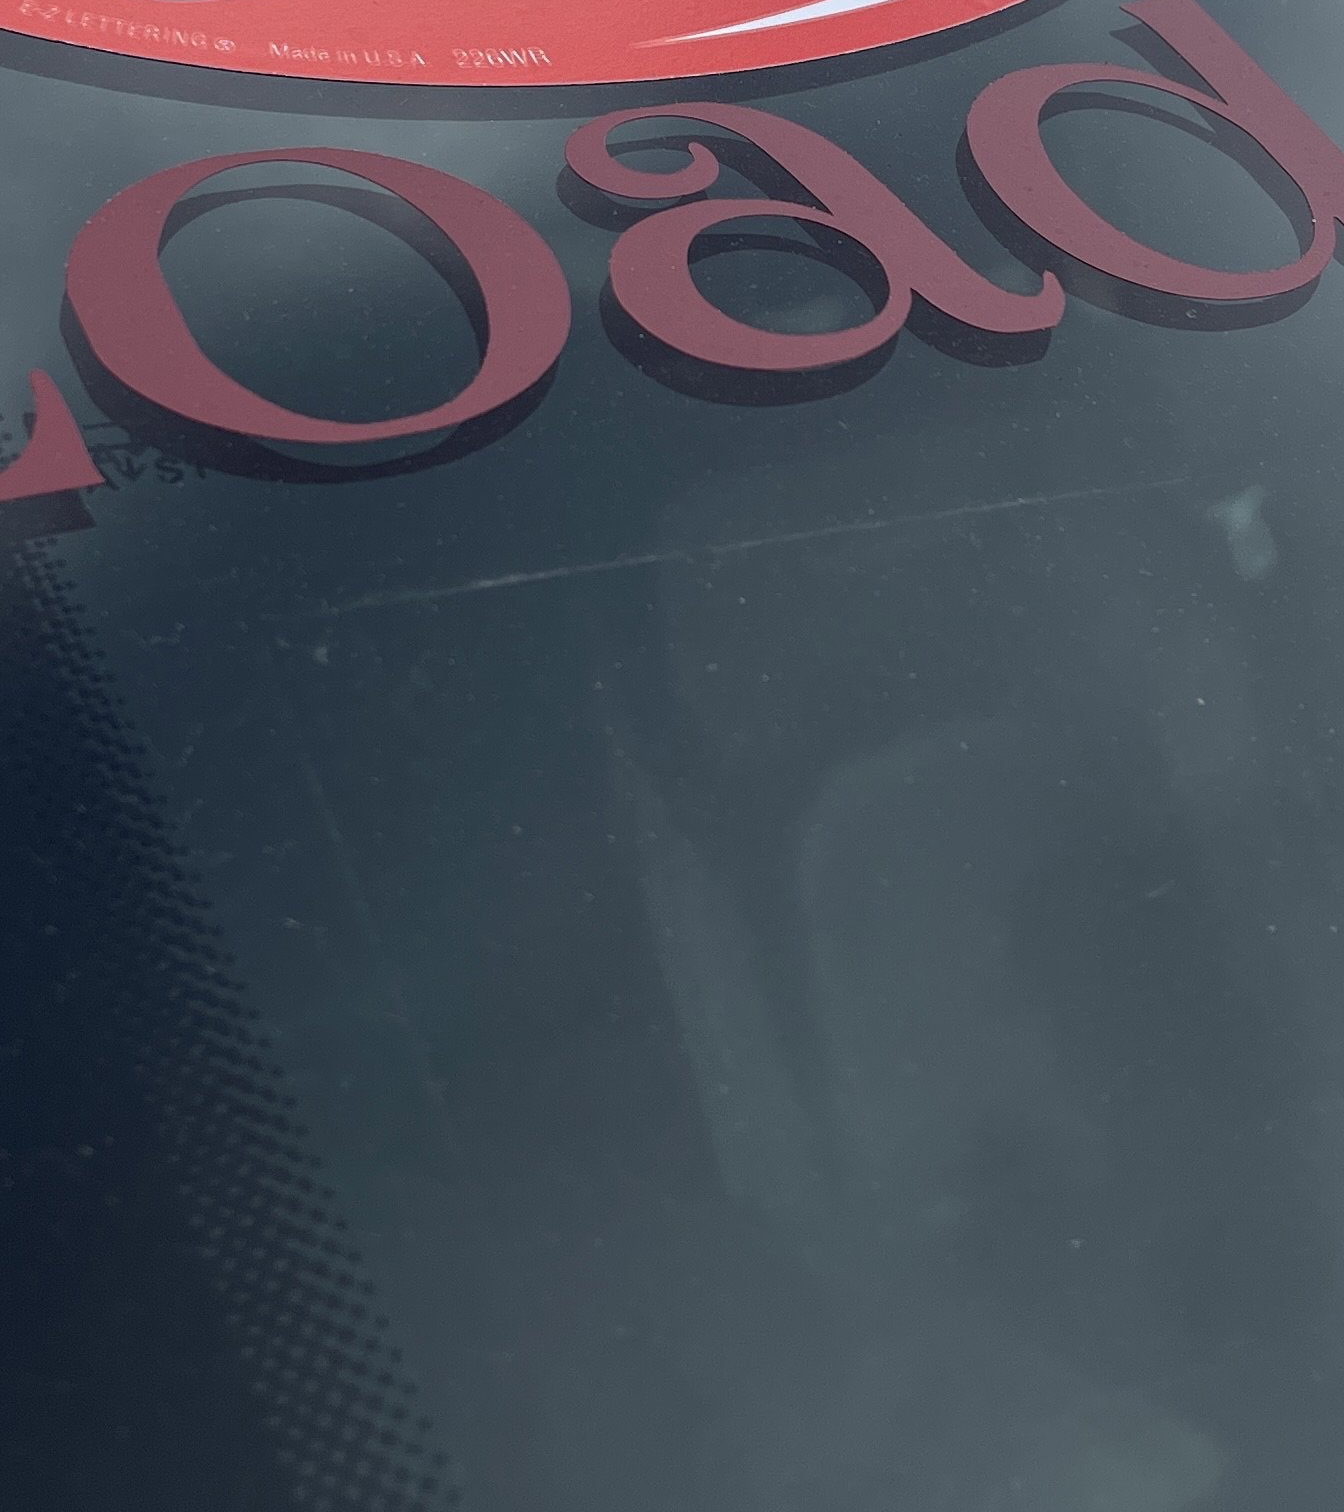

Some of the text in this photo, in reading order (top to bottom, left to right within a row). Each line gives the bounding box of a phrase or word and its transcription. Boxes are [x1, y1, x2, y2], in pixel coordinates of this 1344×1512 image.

[65, 8, 209, 49] LETTERING
[267, 40, 331, 62] Made
[336, 49, 359, 65] in
